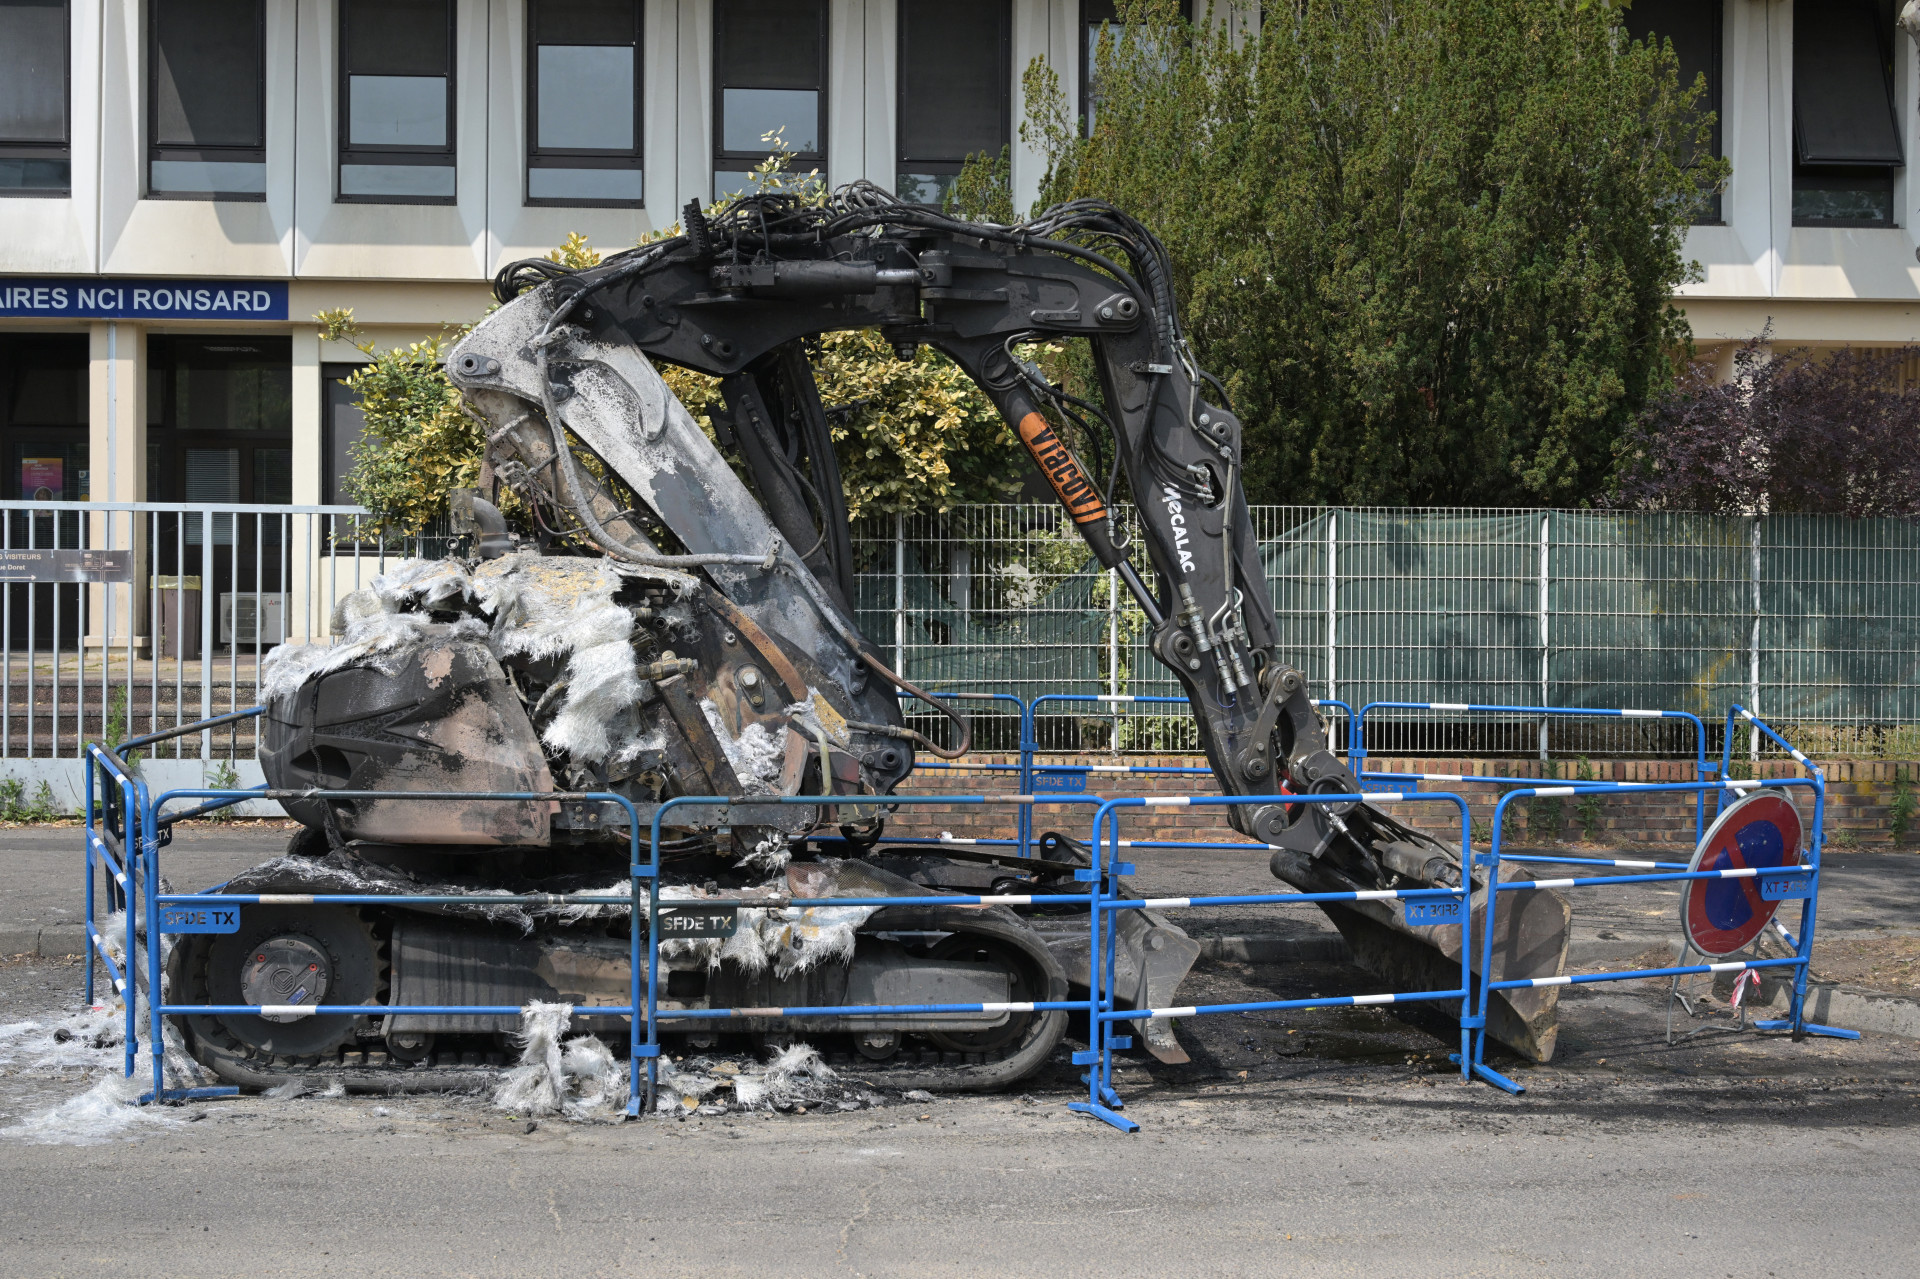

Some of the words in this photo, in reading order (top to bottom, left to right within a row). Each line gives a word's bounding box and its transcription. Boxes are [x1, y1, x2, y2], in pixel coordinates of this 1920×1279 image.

[0, 287, 68, 309] IRES
[78, 288, 123, 309] NCI
[133, 289, 271, 311] RONSARD
[1036, 776, 1064, 786] SFDE
[1068, 777, 1082, 786] TX
[1398, 785, 1413, 793] TX
[158, 828, 169, 840] TX
[164, 911, 207, 925] SFDE
[212, 911, 235, 925] TX
[663, 916, 704, 931] SFDE
[709, 915, 732, 930] TX
